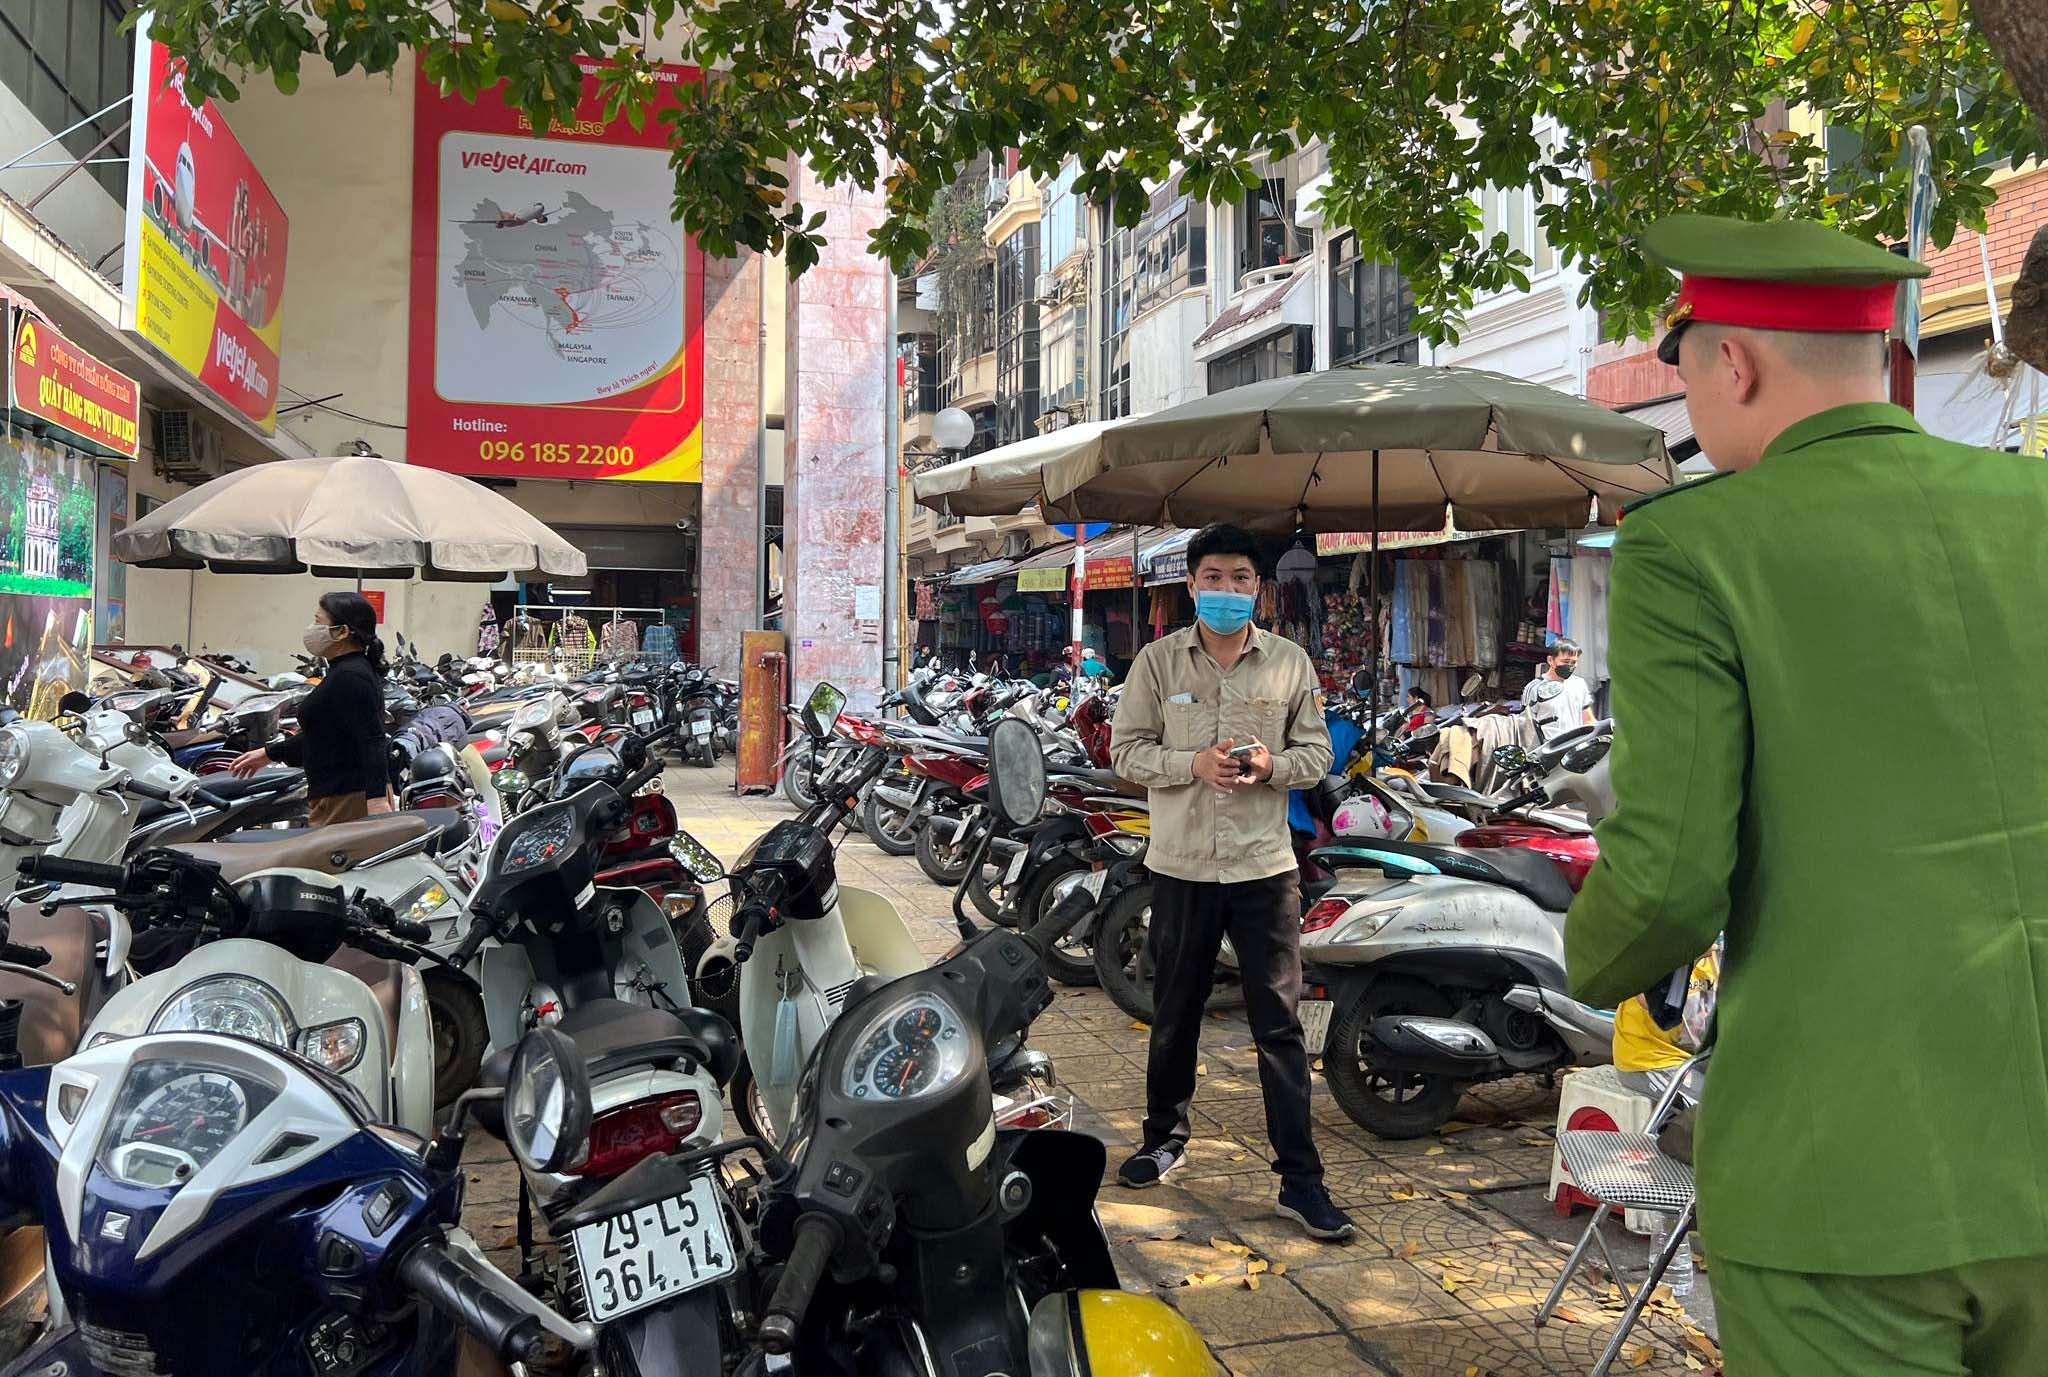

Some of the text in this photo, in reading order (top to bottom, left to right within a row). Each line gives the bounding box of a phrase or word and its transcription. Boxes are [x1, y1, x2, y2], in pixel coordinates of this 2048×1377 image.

[534, 244, 558, 252] CHINA
[464, 269, 486, 278] INDIA
[498, 295, 537, 304] MYANMAR
[606, 294, 635, 302] TAIWAN
[558, 343, 592, 351] MALAYSIA
[567, 356, 608, 365] SINGAPORE
[63, 382, 83, 419] HÀNG
[83, 399, 102, 433] PHỤC
[101, 408, 112, 439] VỤ
[452, 417, 508, 433] Hotline:
[479, 440, 634, 466] 096 185 2200
[299, 892, 339, 905] HONDA
[596, 1193, 700, 1259] 29-L5
[594, 1230, 724, 1312] 364.14
